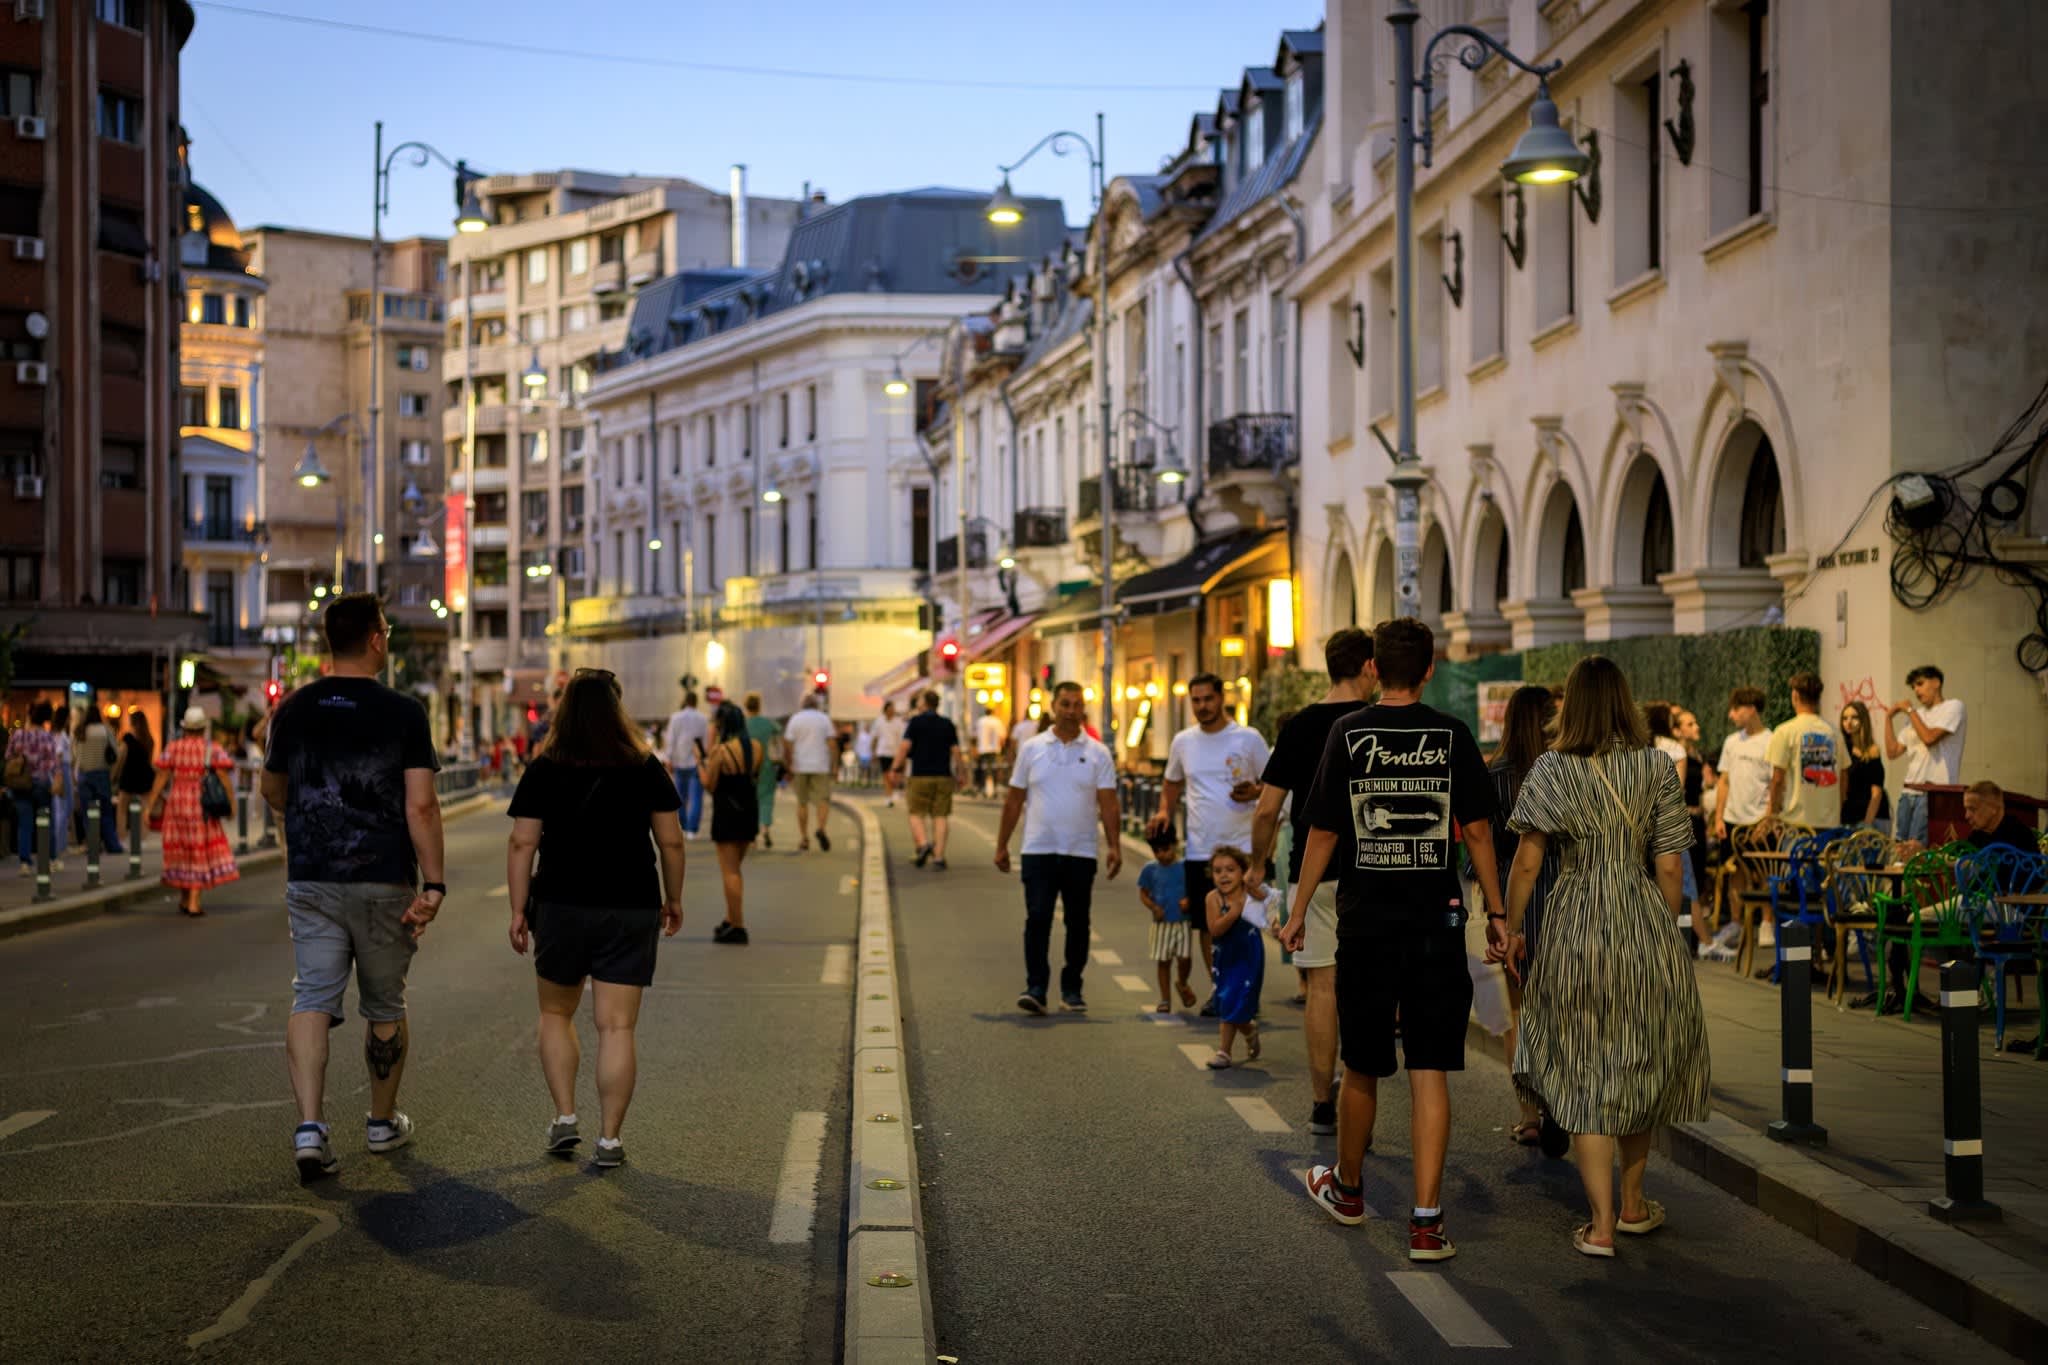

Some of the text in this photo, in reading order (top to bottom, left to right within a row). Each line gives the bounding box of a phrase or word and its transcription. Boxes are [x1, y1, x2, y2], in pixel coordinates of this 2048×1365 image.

[1351, 734, 1448, 774] Fender
[1401, 780, 1442, 792] QUALITY
[1374, 842, 1405, 853] CRAFTED
[1391, 854, 1412, 865] MADE
